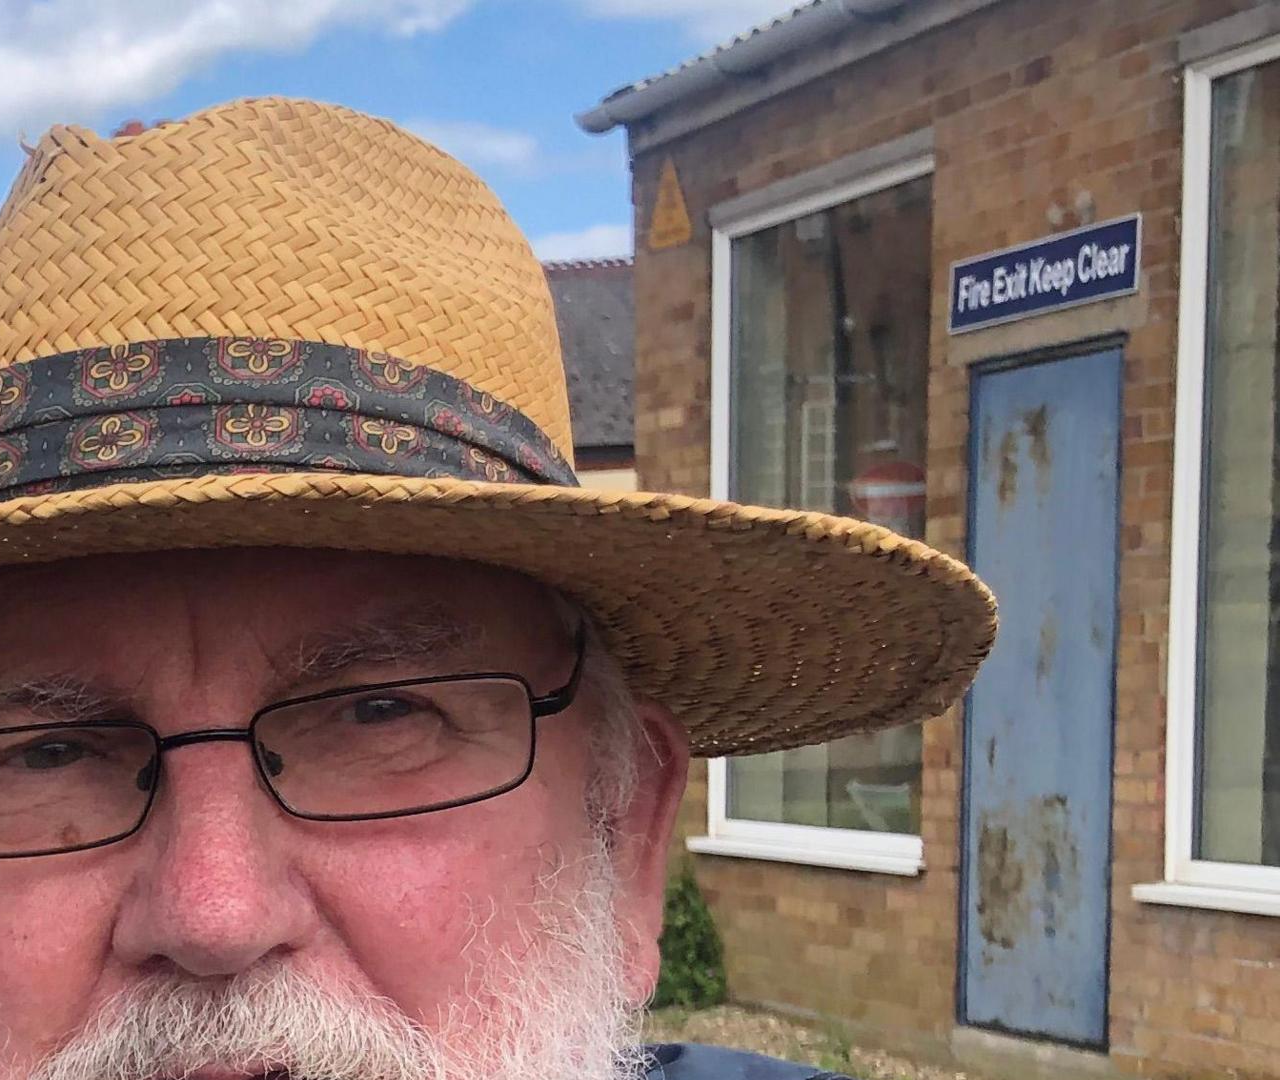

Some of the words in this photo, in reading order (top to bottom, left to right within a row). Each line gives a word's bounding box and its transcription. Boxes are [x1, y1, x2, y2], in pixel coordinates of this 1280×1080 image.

[957, 275, 989, 313] Fire
[993, 262, 1027, 304] Exit
[1029, 257, 1075, 296] Keep
[1078, 244, 1130, 283] Clear
